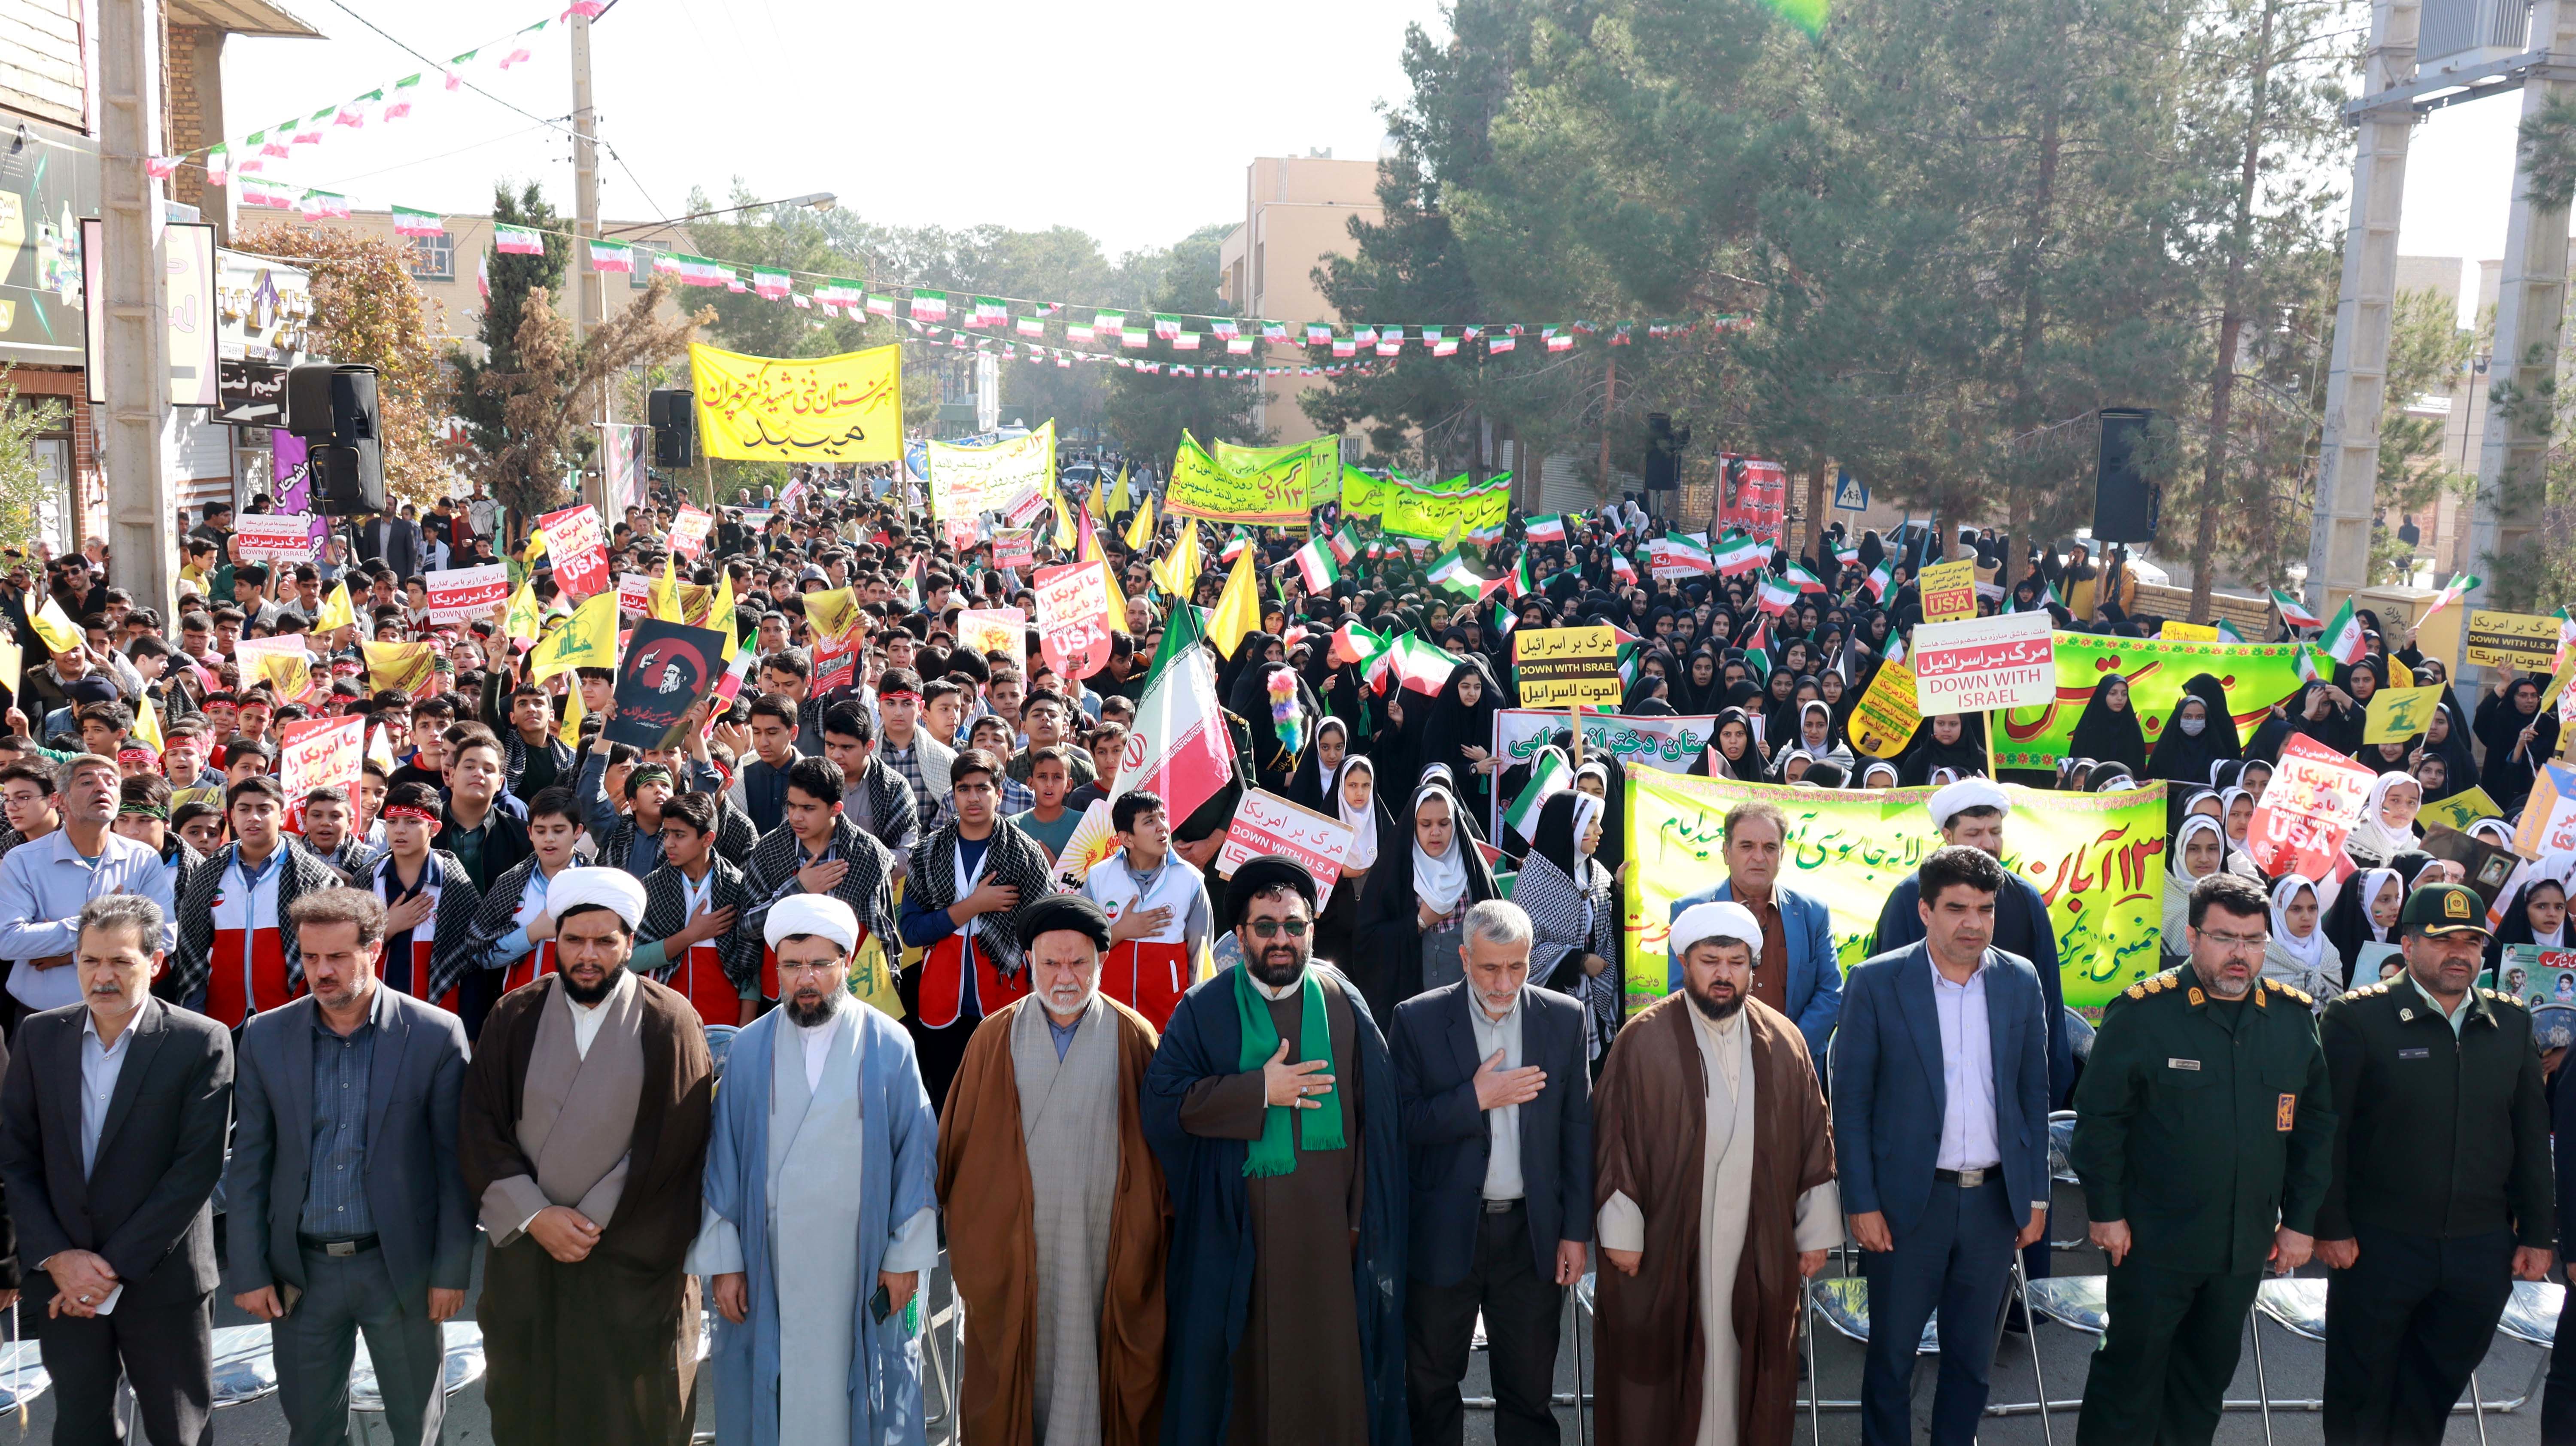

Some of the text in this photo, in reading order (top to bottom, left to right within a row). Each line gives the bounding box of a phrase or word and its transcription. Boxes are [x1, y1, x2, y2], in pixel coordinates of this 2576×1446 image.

[221, 369, 285, 397] گیم نت
[583, 516, 593, 524] ما
[950, 521, 975, 535] USA
[286, 536, 307, 548] مرگ
[673, 535, 698, 550] USA
[561, 545, 598, 566] DOWN WITH
[562, 553, 605, 580] USA
[482, 586, 504, 599] مرگ
[1040, 575, 1099, 612] ما آمریکا را
[432, 610, 461, 619] DOWN
[464, 607, 484, 617] WITH
[1930, 595, 1969, 614] USA
[1051, 614, 1099, 639] DOWN WITH
[2010, 630, 2028, 639] عاشق
[2474, 616, 2557, 636] مرگ بر امریکا
[1052, 623, 1106, 656] USA
[1521, 632, 1612, 656] مرگ بر اسرائیل
[2470, 635, 2556, 650] DOWN WITH U.S.A
[2008, 642, 2048, 663] مرگ
[2515, 656, 2552, 668] الموت
[1520, 662, 1616, 675] DOWN WITH ISRAEL
[1930, 668, 2041, 693] DOWN WITH
[1581, 683, 1618, 701] الموت
[1871, 687, 1888, 700] DOWN
[1959, 689, 2019, 708] ISRAEL
[287, 732, 357, 775] ما آمریکا را
[2329, 755, 2345, 763] امام
[2283, 762, 2362, 795] ما آمریکا را
[293, 799, 307, 811] DO
[2326, 799, 2335, 817] پا
[2337, 805, 2354, 821] زیر
[1244, 799, 1343, 854] مرگ بر امریکا
[2271, 808, 2335, 833] DOWN WITH
[2267, 817, 2330, 857] USA
[1231, 824, 1335, 878] DOWN WITH U.S.A
[2118, 835, 2165, 892] ۱۳
[2090, 916, 2160, 982] خمینی
